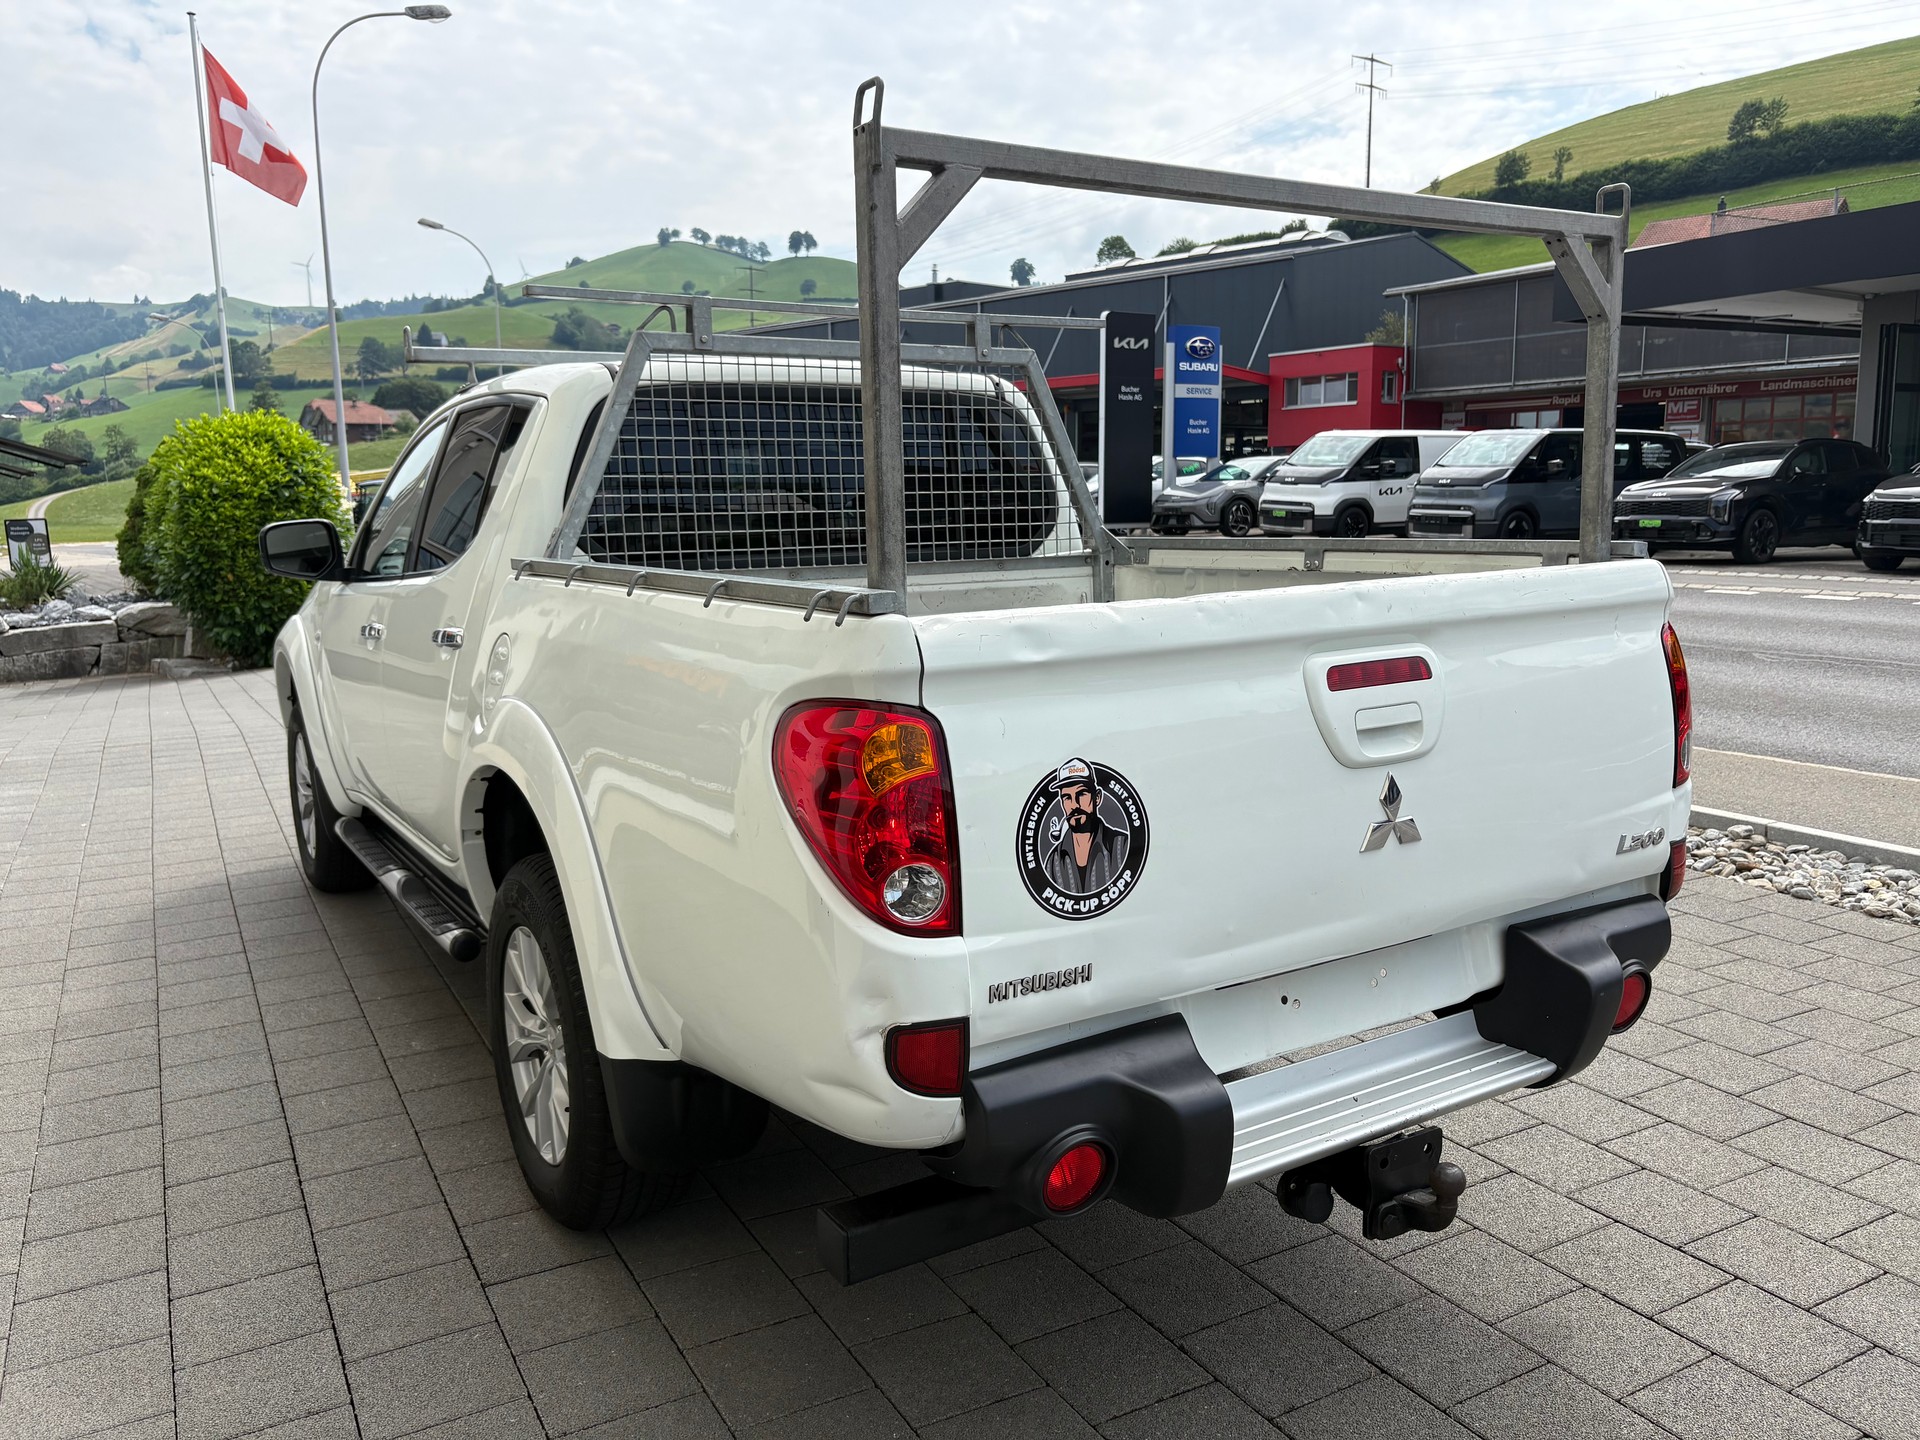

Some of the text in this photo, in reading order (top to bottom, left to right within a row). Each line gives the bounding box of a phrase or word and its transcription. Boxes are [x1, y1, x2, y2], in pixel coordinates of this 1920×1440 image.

[1113, 336, 1149, 350] KIA
[1179, 362, 1219, 372] SUBARU
[1118, 393, 1134, 401] Hasle
[1186, 387, 1212, 395] SERVICE
[1643, 388, 1662, 398] Urs
[1668, 384, 1738, 397] Unternährer
[1552, 393, 1581, 406] Rapid
[1667, 400, 1698, 414] MF
[1378, 486, 1403, 496] KIA
[1108, 780, 1141, 827] SEIT 2009
[1025, 796, 1047, 869] ENTLEBUCH
[1616, 827, 1665, 855] L200
[1041, 869, 1132, 913] PICK-UP SÖPP
[988, 963, 1093, 1004] MITSUBISHI
